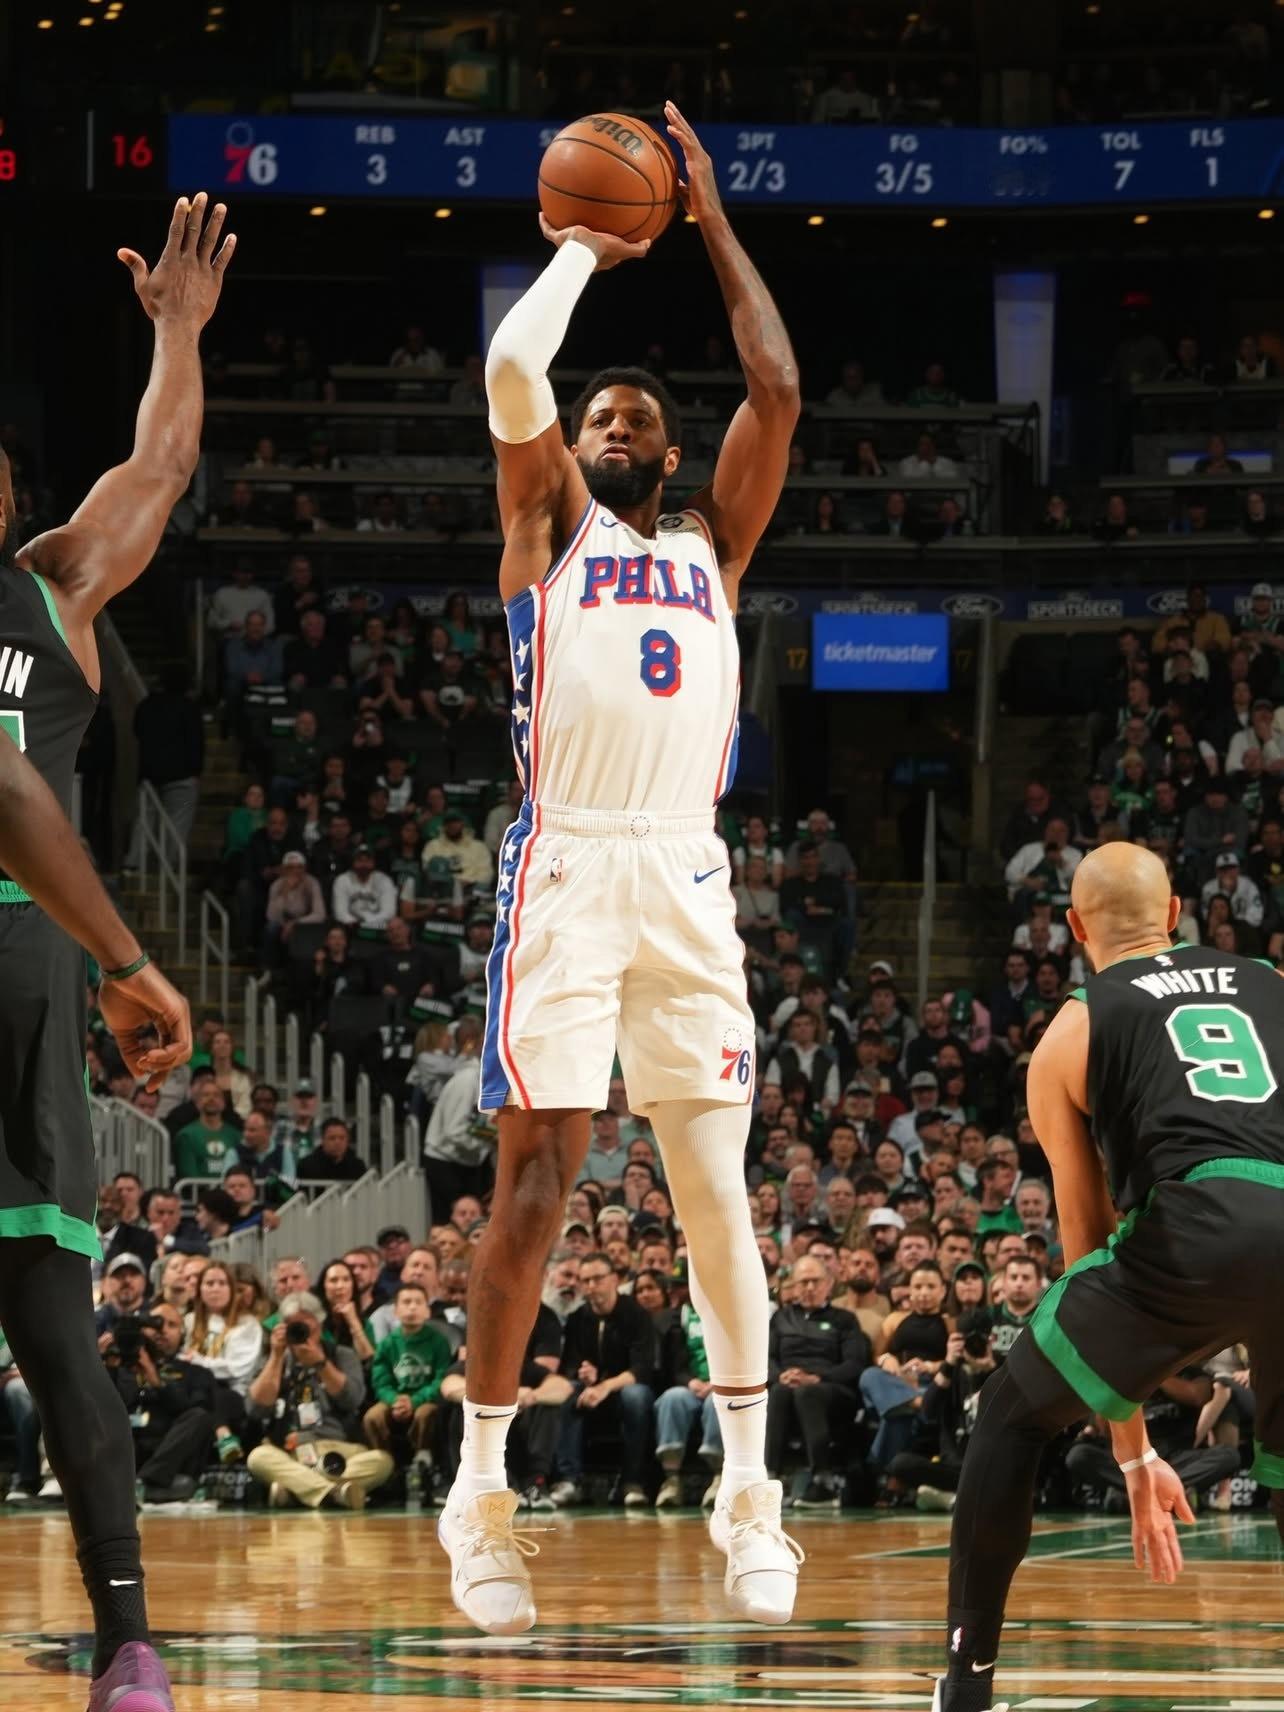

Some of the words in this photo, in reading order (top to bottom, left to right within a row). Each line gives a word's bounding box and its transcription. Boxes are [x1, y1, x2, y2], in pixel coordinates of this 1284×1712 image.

[355, 125, 395, 145] REB
[444, 127, 485, 146] AST
[737, 132, 776, 151] 3PT
[889, 135, 919, 153] FG
[999, 136, 1047, 155] FG%
[1101, 132, 1142, 151] TOL
[1189, 128, 1226, 147] FLS
[112, 134, 154, 169] 16
[224, 143, 278, 186] 76
[366, 154, 388, 185] 3
[456, 157, 477, 187] 3
[728, 159, 786, 192] 2/3
[875, 160, 934, 194] 3/5
[1113, 160, 1136, 191] 7
[1205, 157, 1219, 187] 1
[1031, 601, 1122, 617] SPORTSDECK
[640, 628, 682, 698] 8
[786, 648, 808, 671] 17
[823, 640, 938, 663] ticketmaster
[1131, 967, 1239, 999] WHITE
[719, 1046, 751, 1085] 76
[1165, 1003, 1278, 1103] 9
